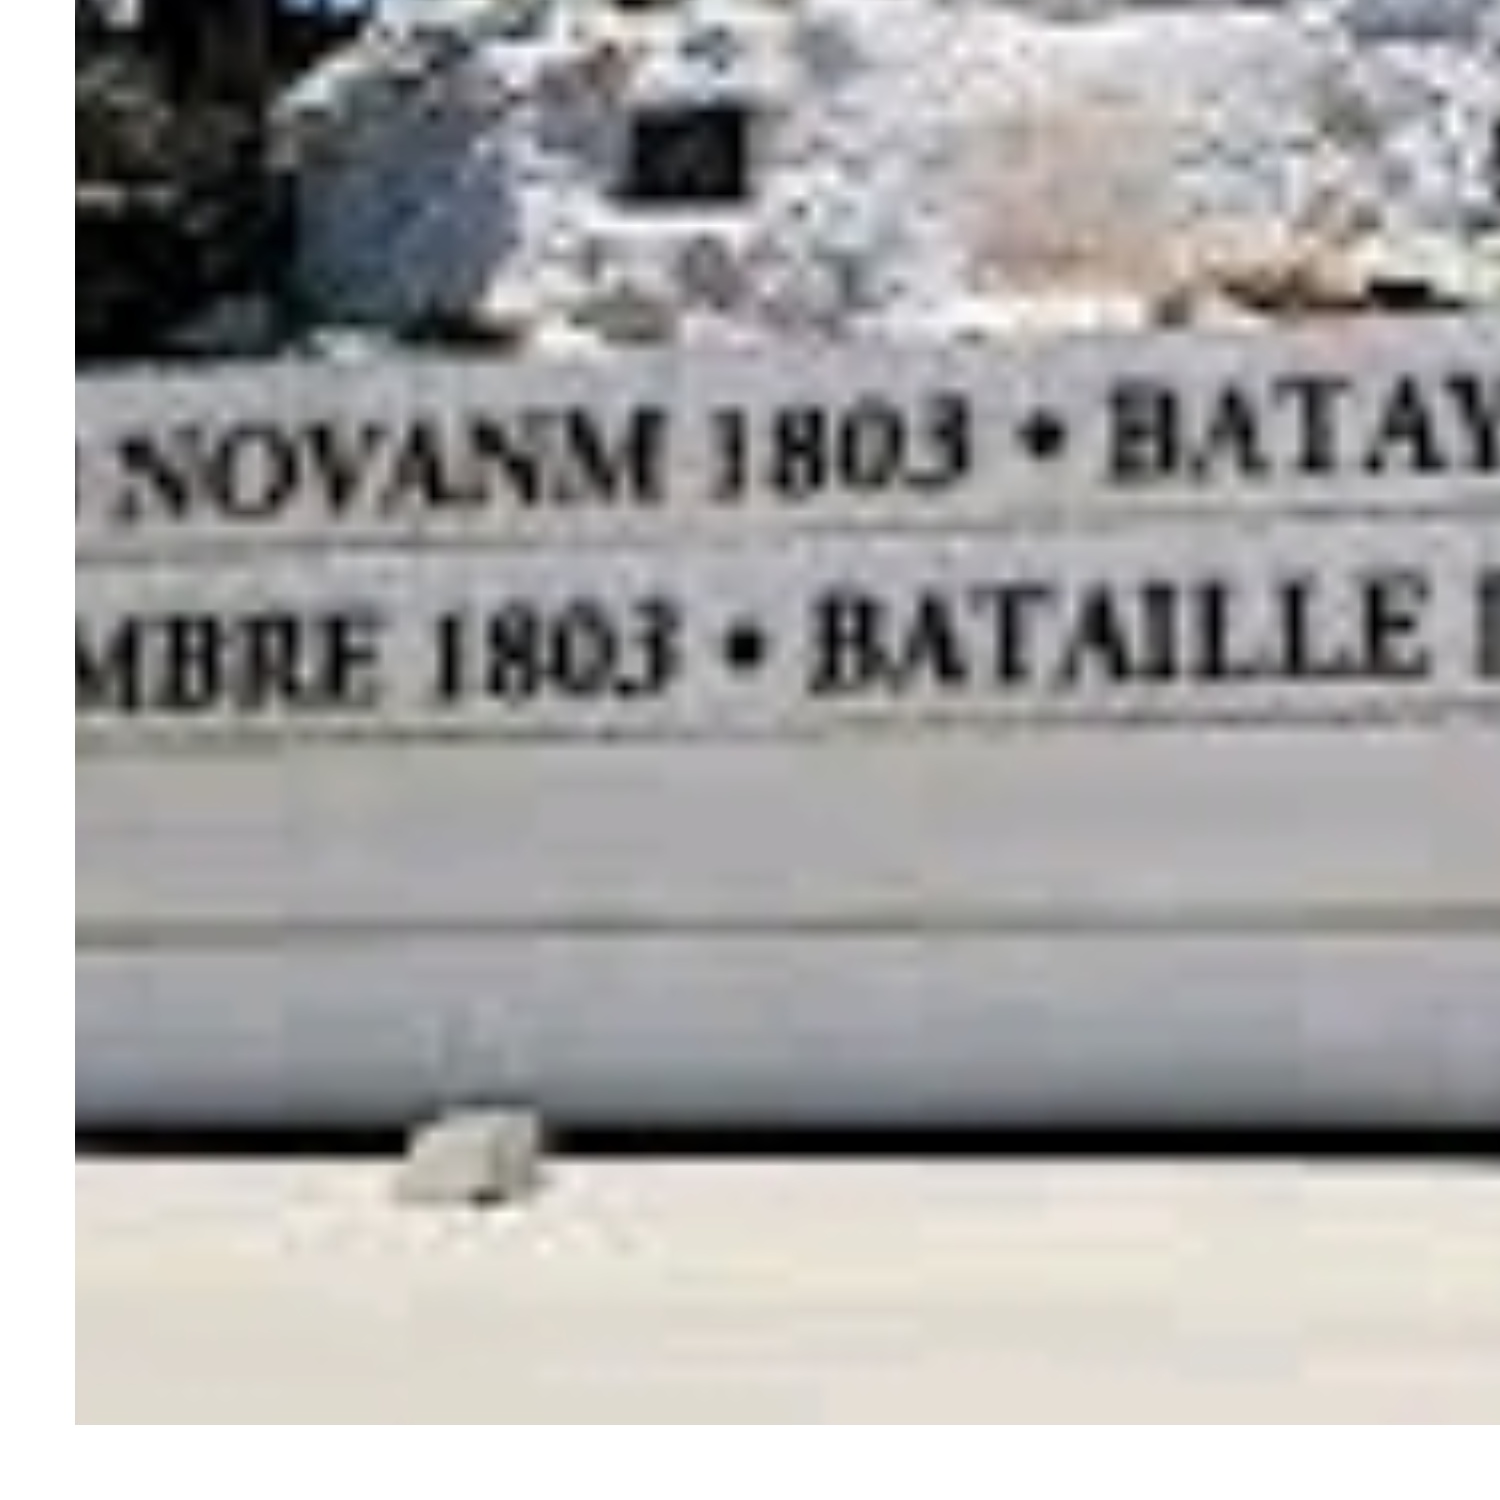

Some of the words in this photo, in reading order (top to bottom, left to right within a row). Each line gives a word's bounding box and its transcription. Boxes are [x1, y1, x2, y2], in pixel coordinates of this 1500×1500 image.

[113, 409, 666, 524] NOVANM
[710, 393, 972, 504] 1803
[431, 594, 685, 703] 1803
[806, 569, 1432, 695] BATAILLE
